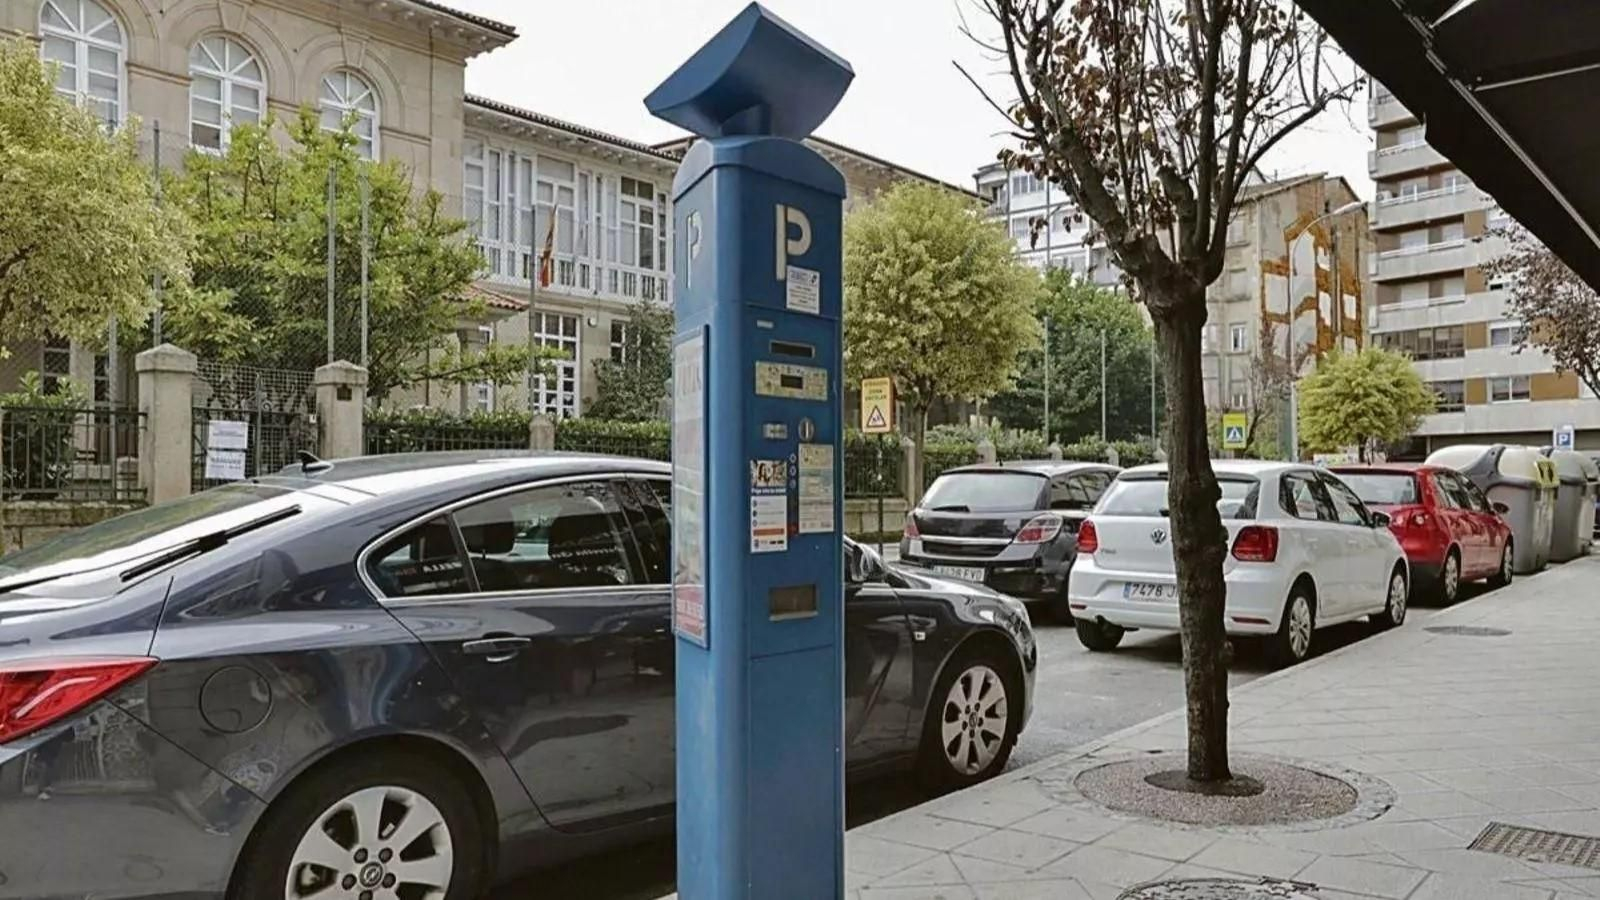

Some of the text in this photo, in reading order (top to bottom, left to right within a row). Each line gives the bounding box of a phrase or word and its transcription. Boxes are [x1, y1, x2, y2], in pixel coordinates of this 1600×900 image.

[686, 211, 702, 289] P
[776, 204, 812, 281] P
[1559, 434, 1569, 445] P
[1131, 583, 1162, 597] 7478
